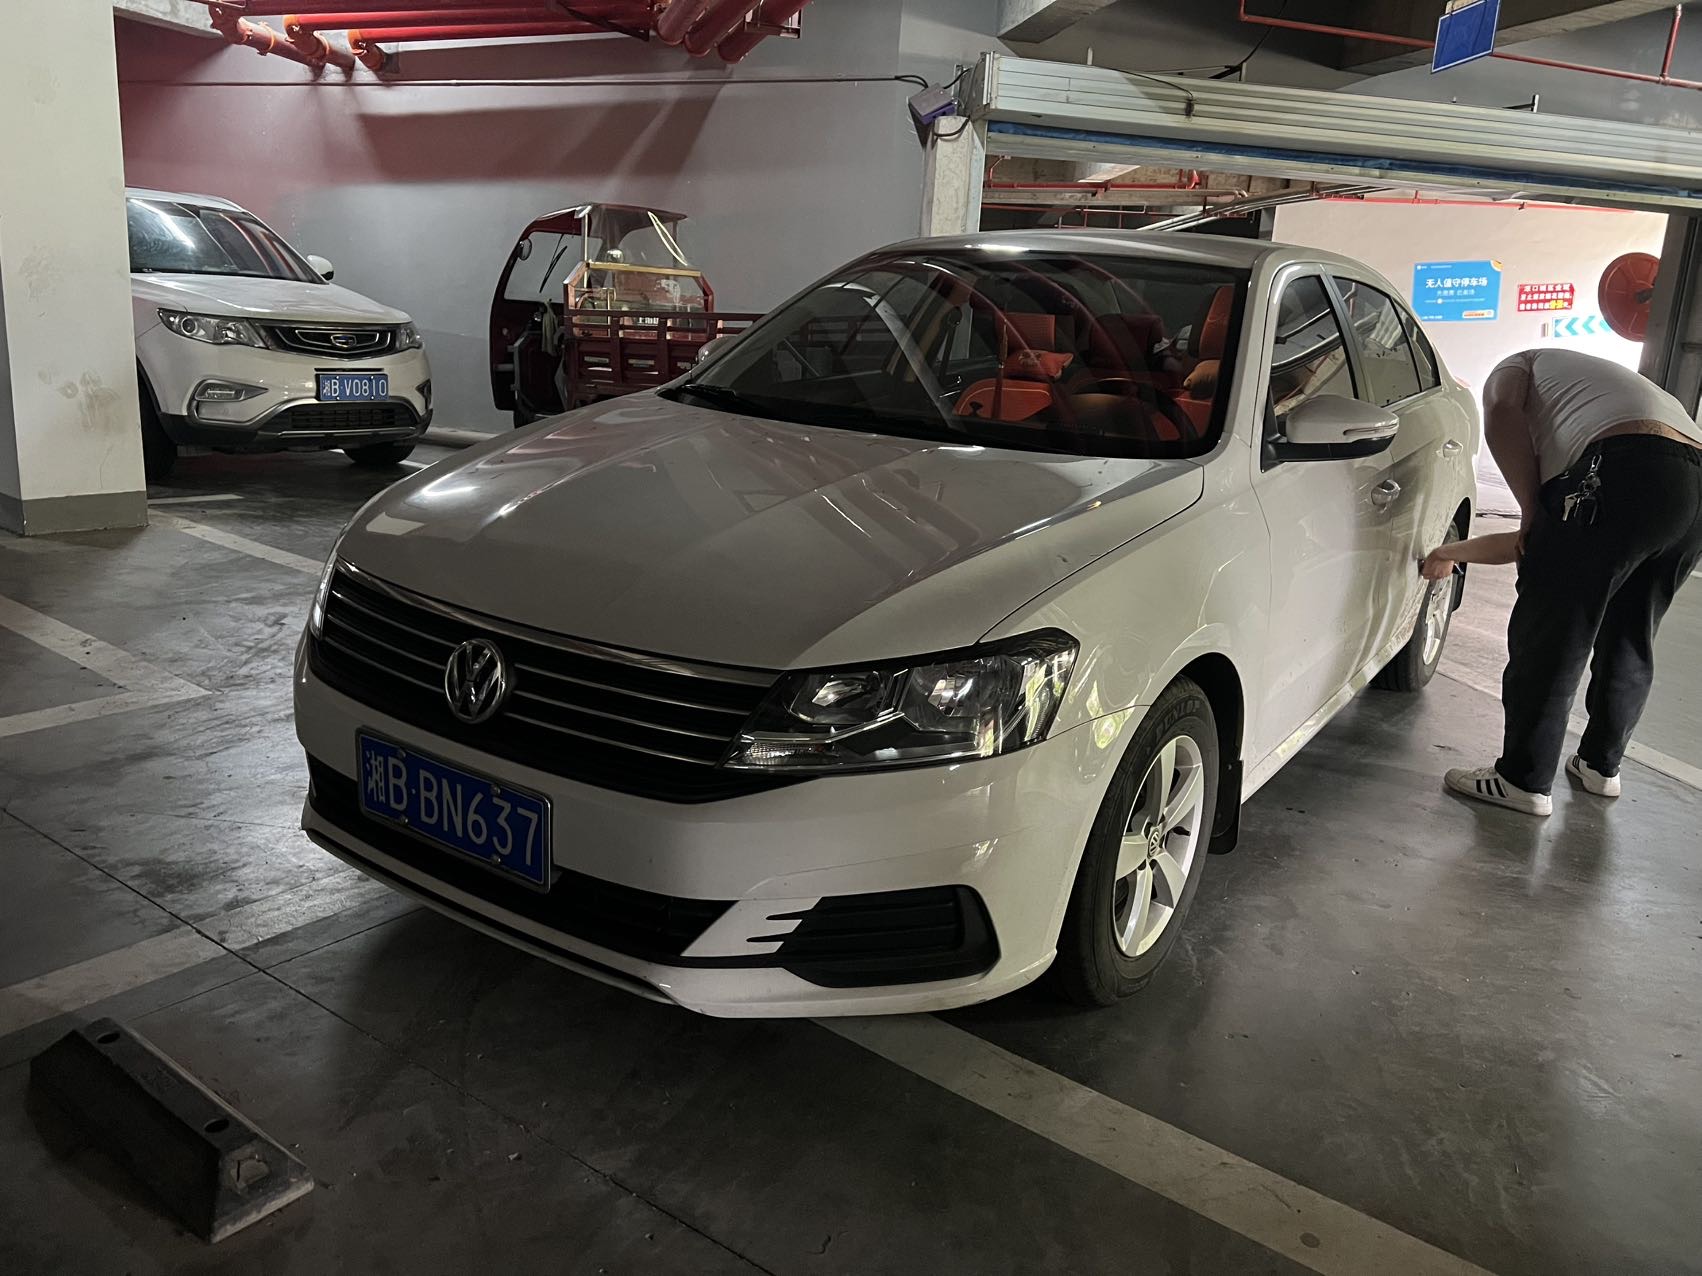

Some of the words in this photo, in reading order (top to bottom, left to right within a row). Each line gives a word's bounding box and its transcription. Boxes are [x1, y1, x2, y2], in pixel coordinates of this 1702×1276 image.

[1425, 277, 1488, 288] 无人值守停车场
[1155, 699, 1201, 743] DUNLOP
